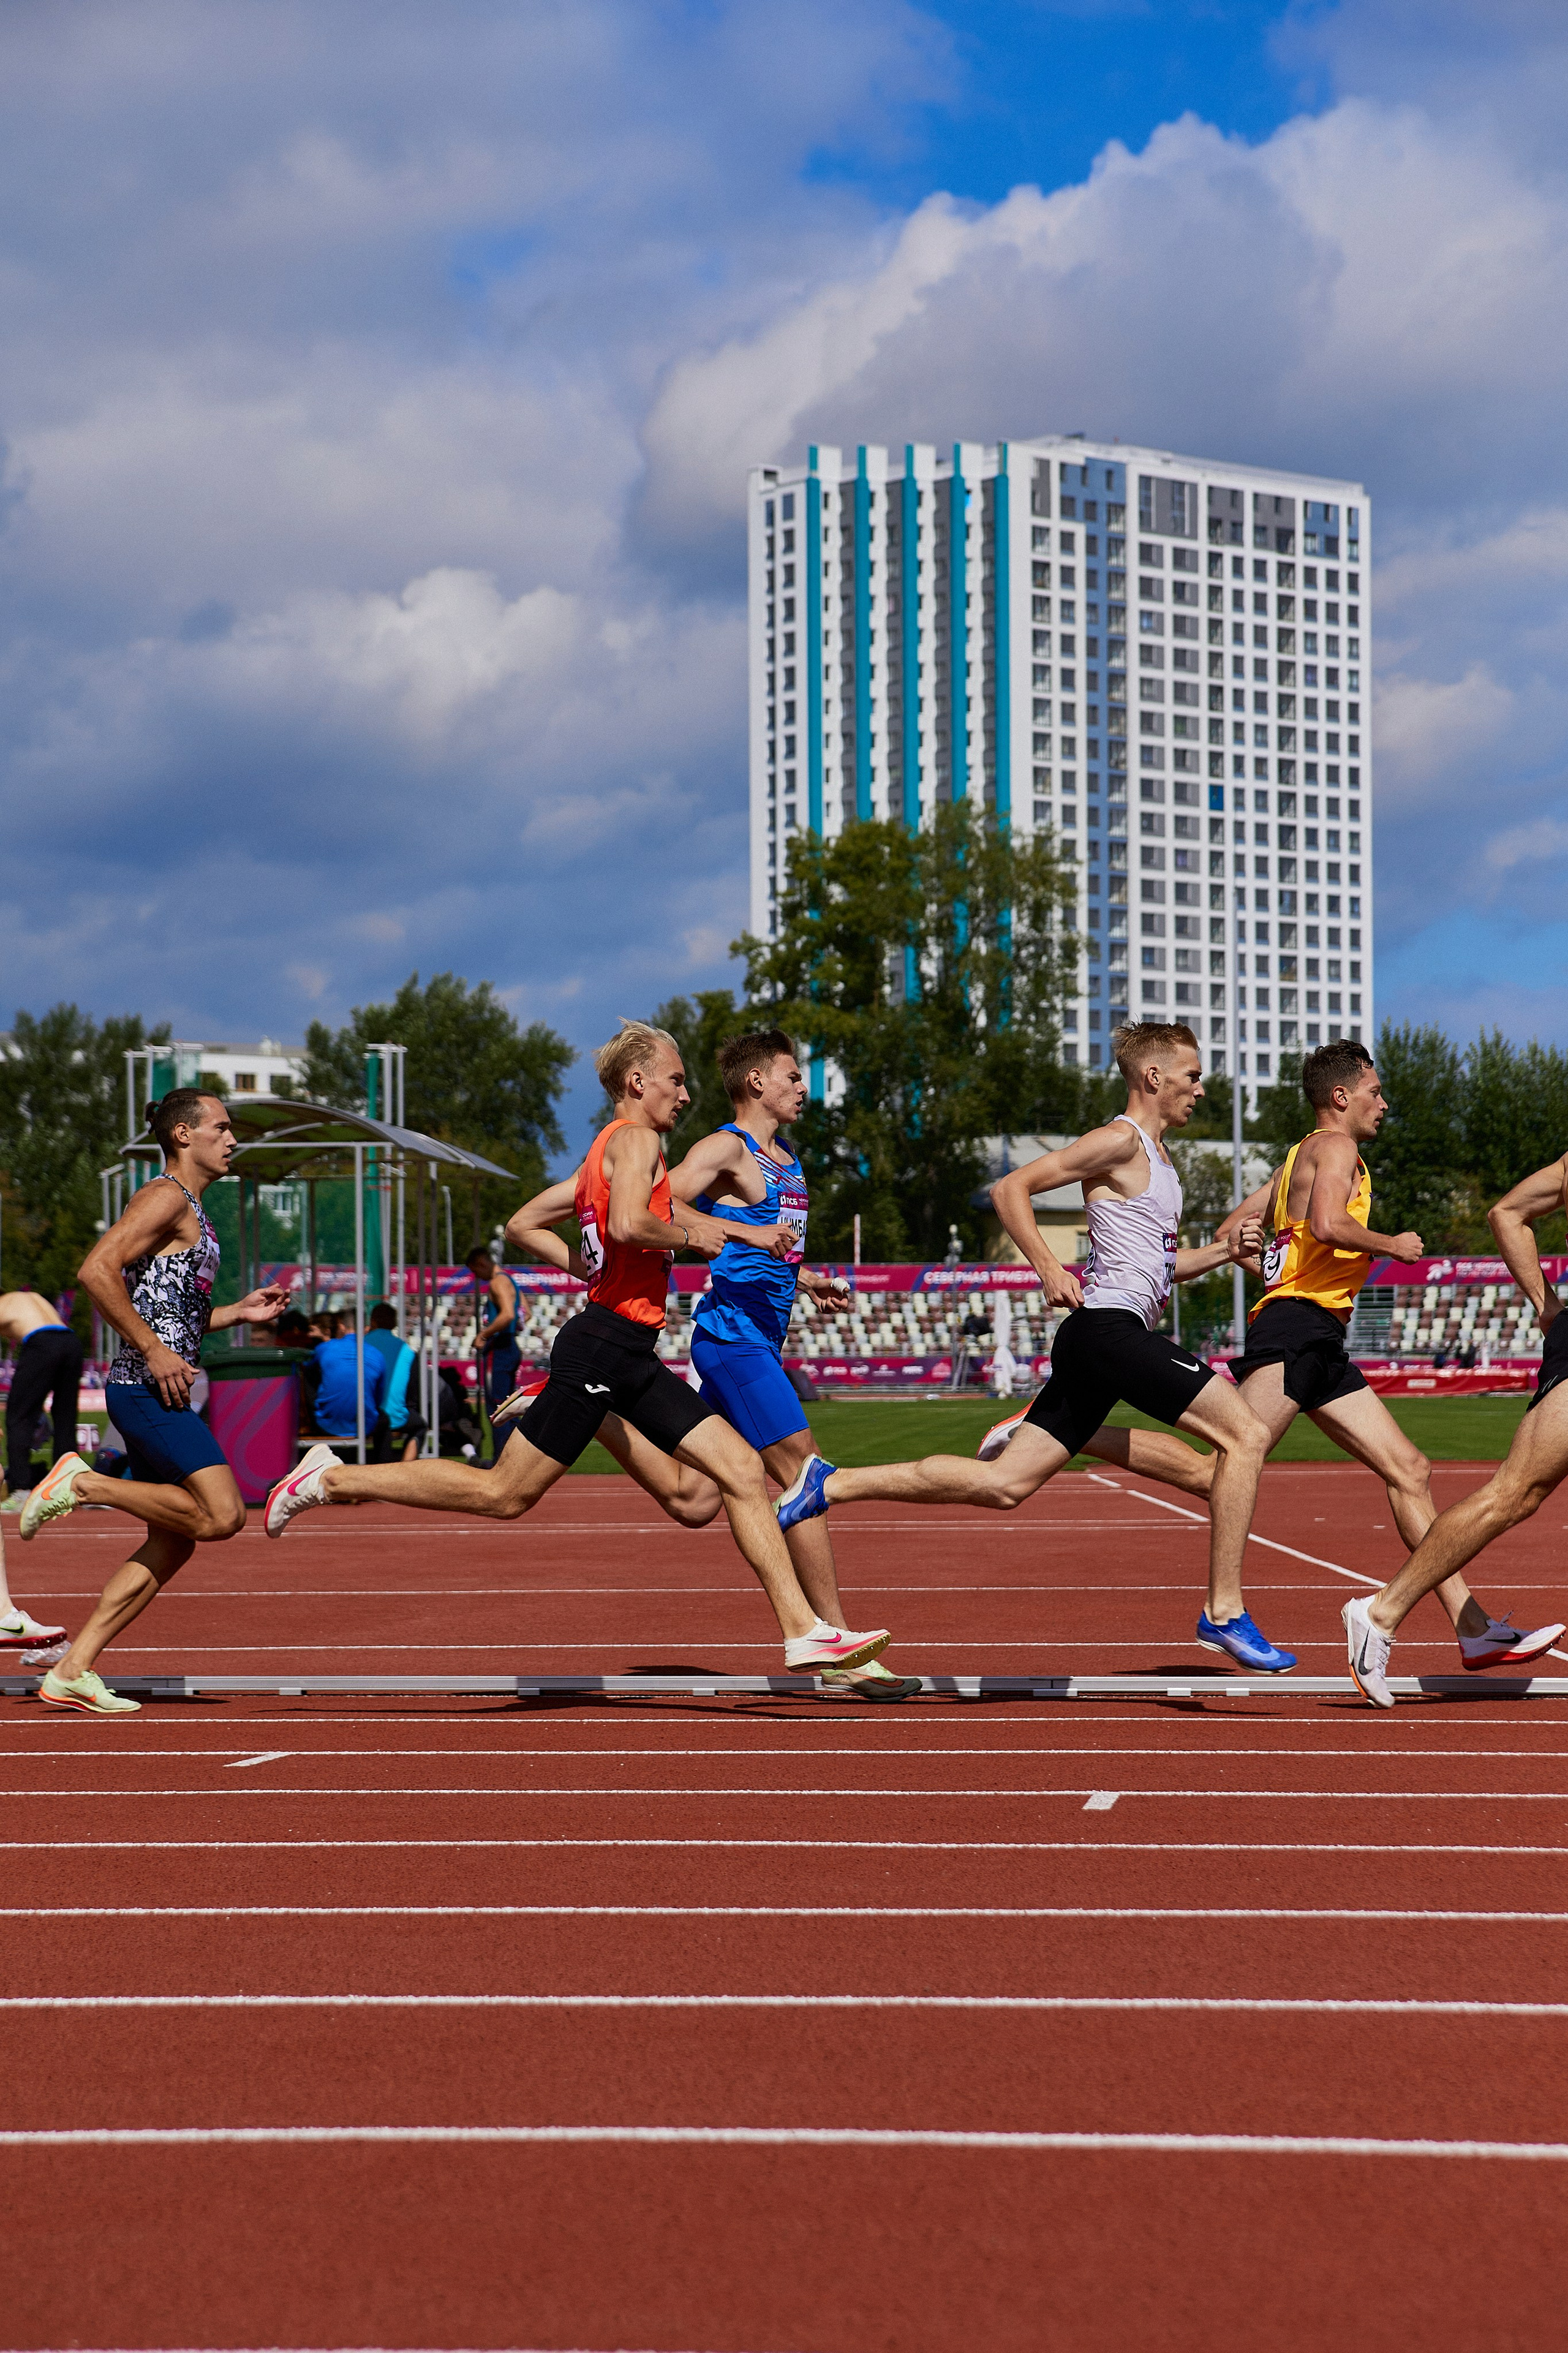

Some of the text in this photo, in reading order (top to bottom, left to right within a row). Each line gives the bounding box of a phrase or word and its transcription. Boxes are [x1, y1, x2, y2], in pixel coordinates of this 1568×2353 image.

[513, 1272, 569, 1286] ЕВЕРНАЯ
[924, 1270, 1042, 1285] СЕВЕРНАЯ ТРИБУН
